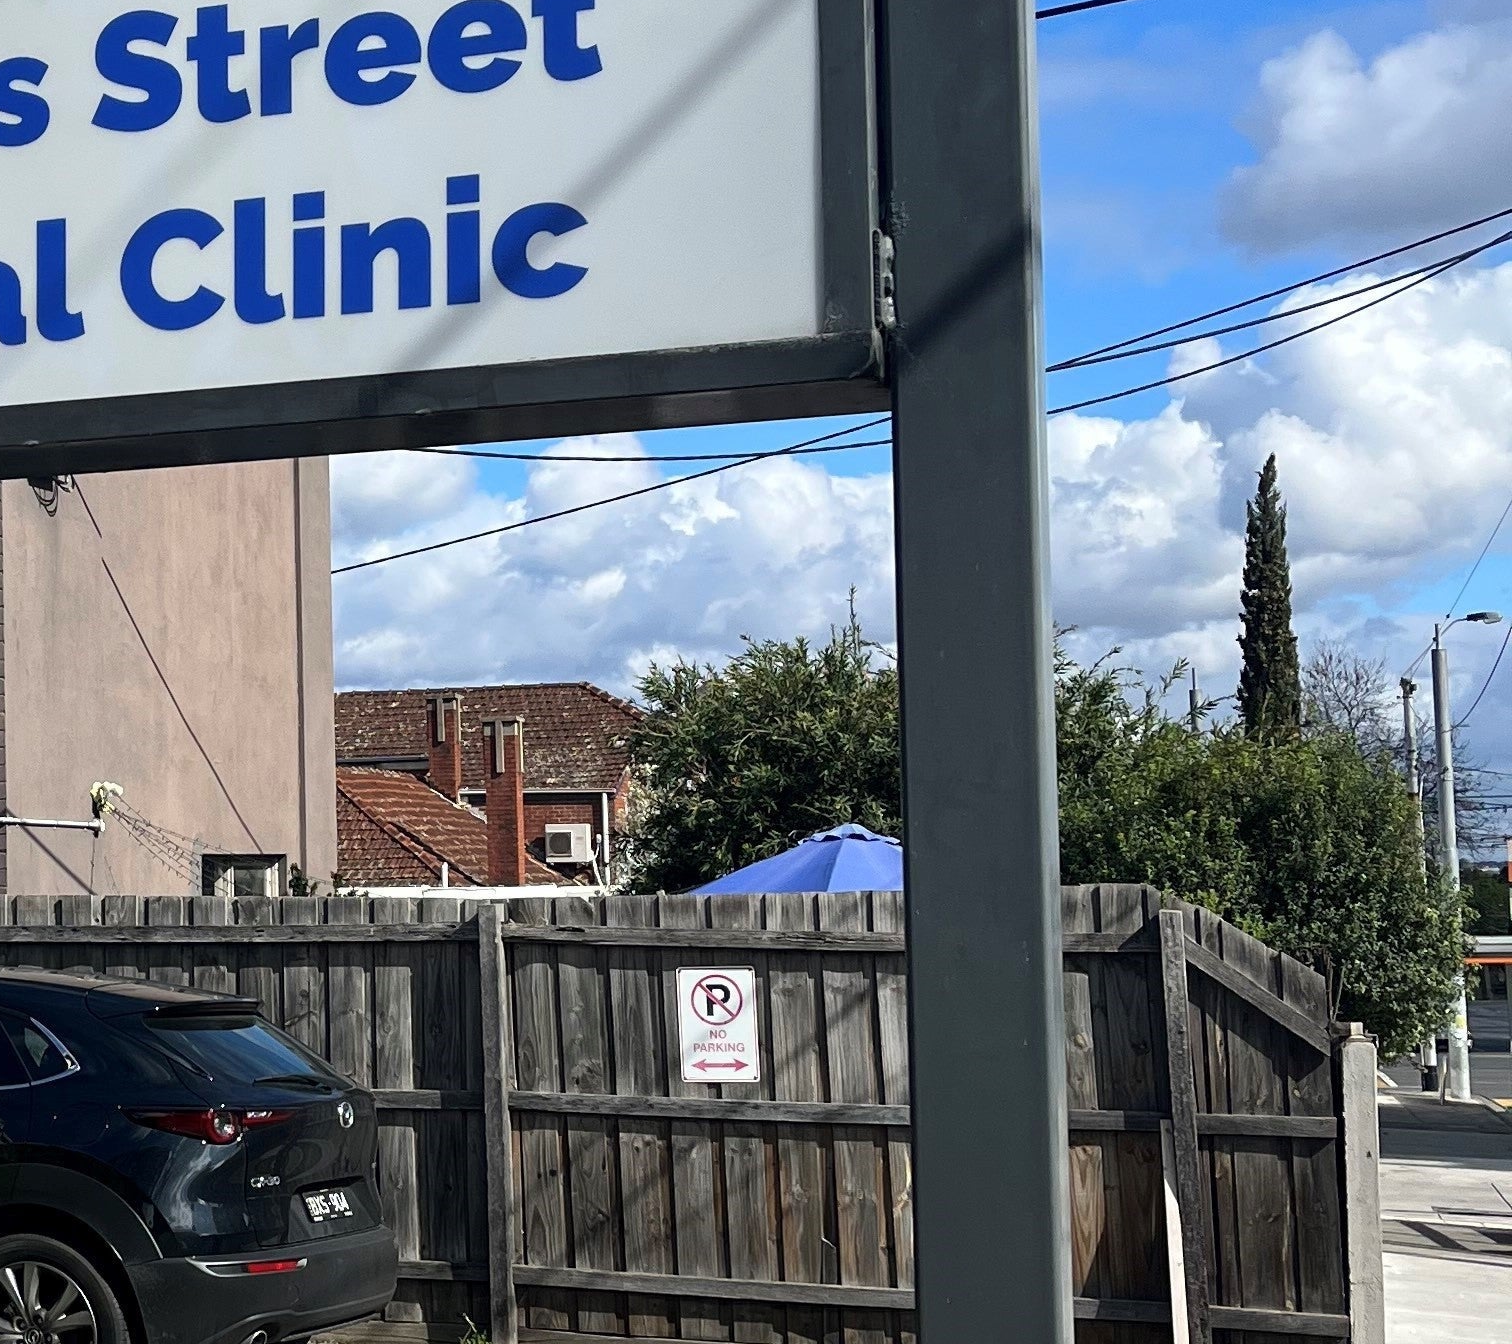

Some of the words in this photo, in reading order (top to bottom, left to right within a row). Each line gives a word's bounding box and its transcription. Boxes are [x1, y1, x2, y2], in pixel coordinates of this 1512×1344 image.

[120, 175, 587, 332] Clinic
[709, 1029, 727, 1039] NO
[693, 1042, 745, 1053] PARKING
